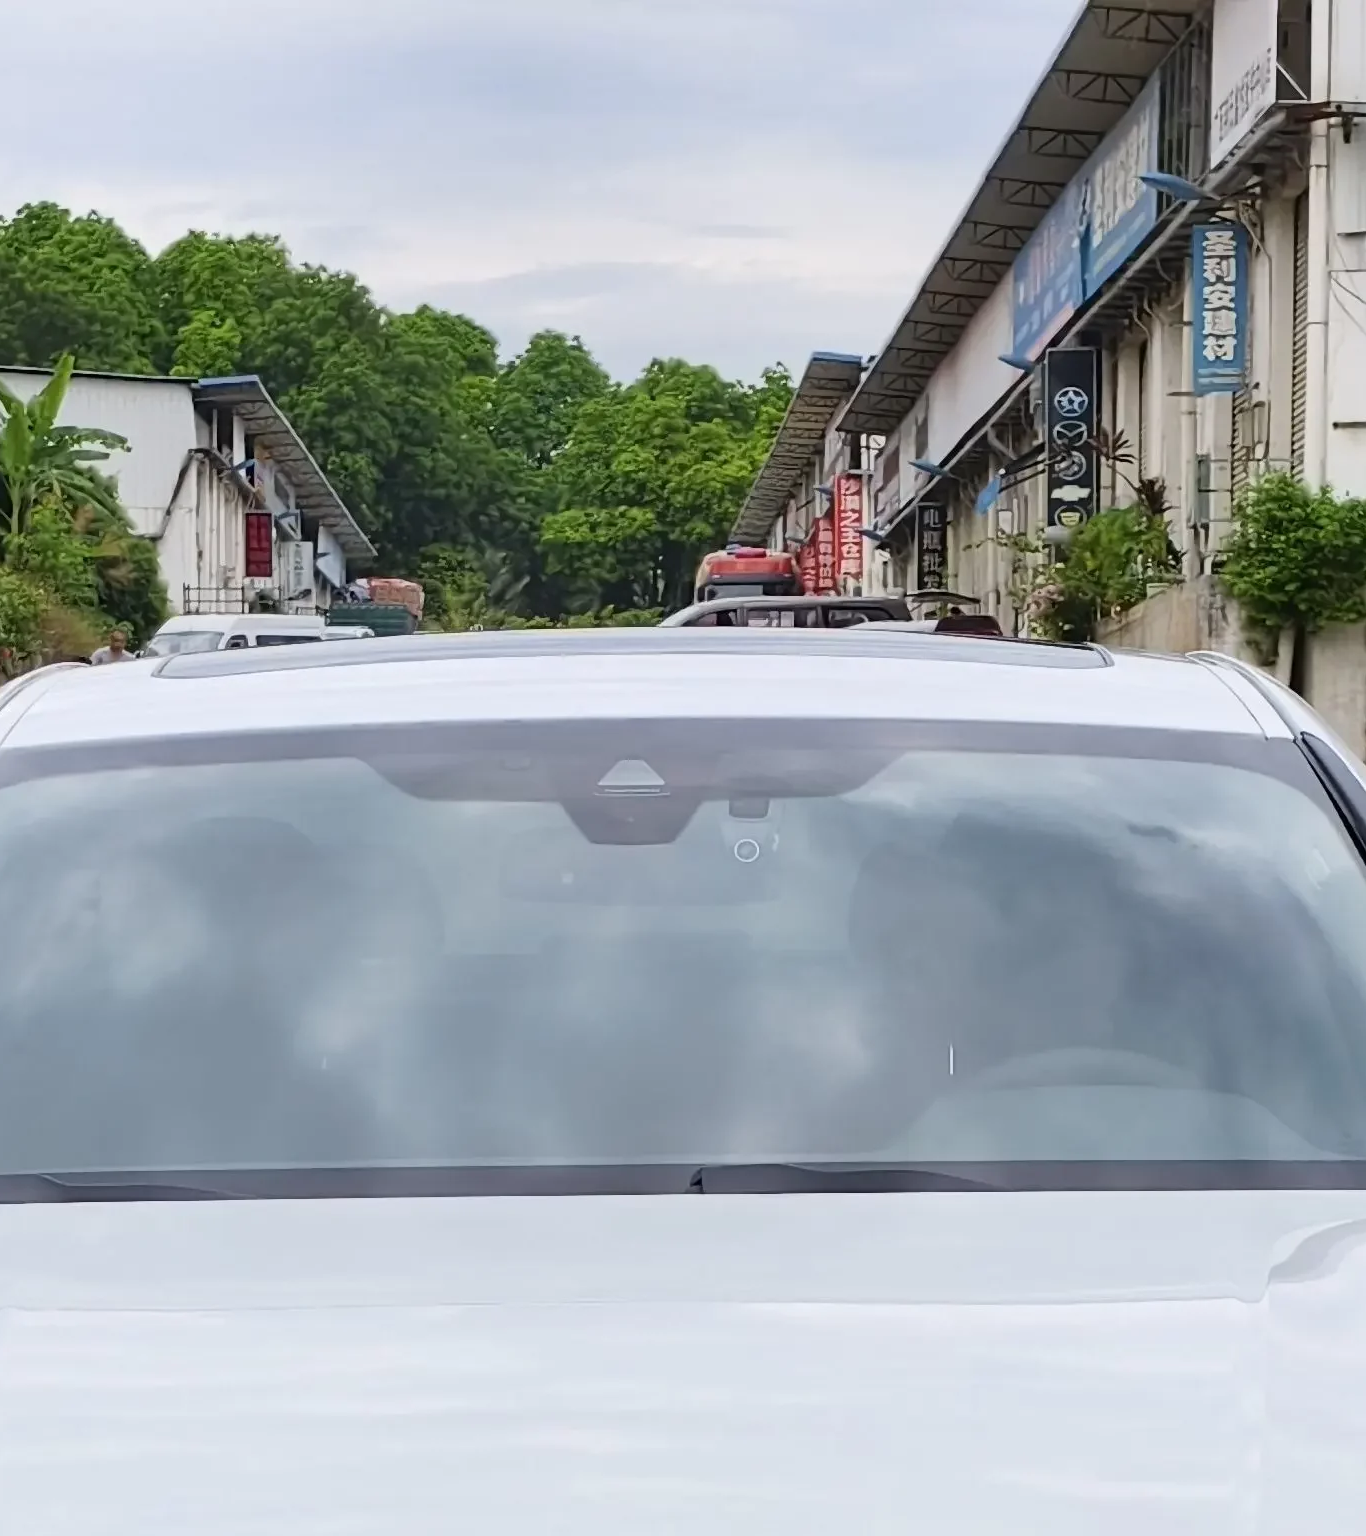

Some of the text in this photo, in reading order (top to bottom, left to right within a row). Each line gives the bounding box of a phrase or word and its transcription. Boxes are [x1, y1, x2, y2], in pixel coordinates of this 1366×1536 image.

[1202, 230, 1237, 361] 圣利安建材
